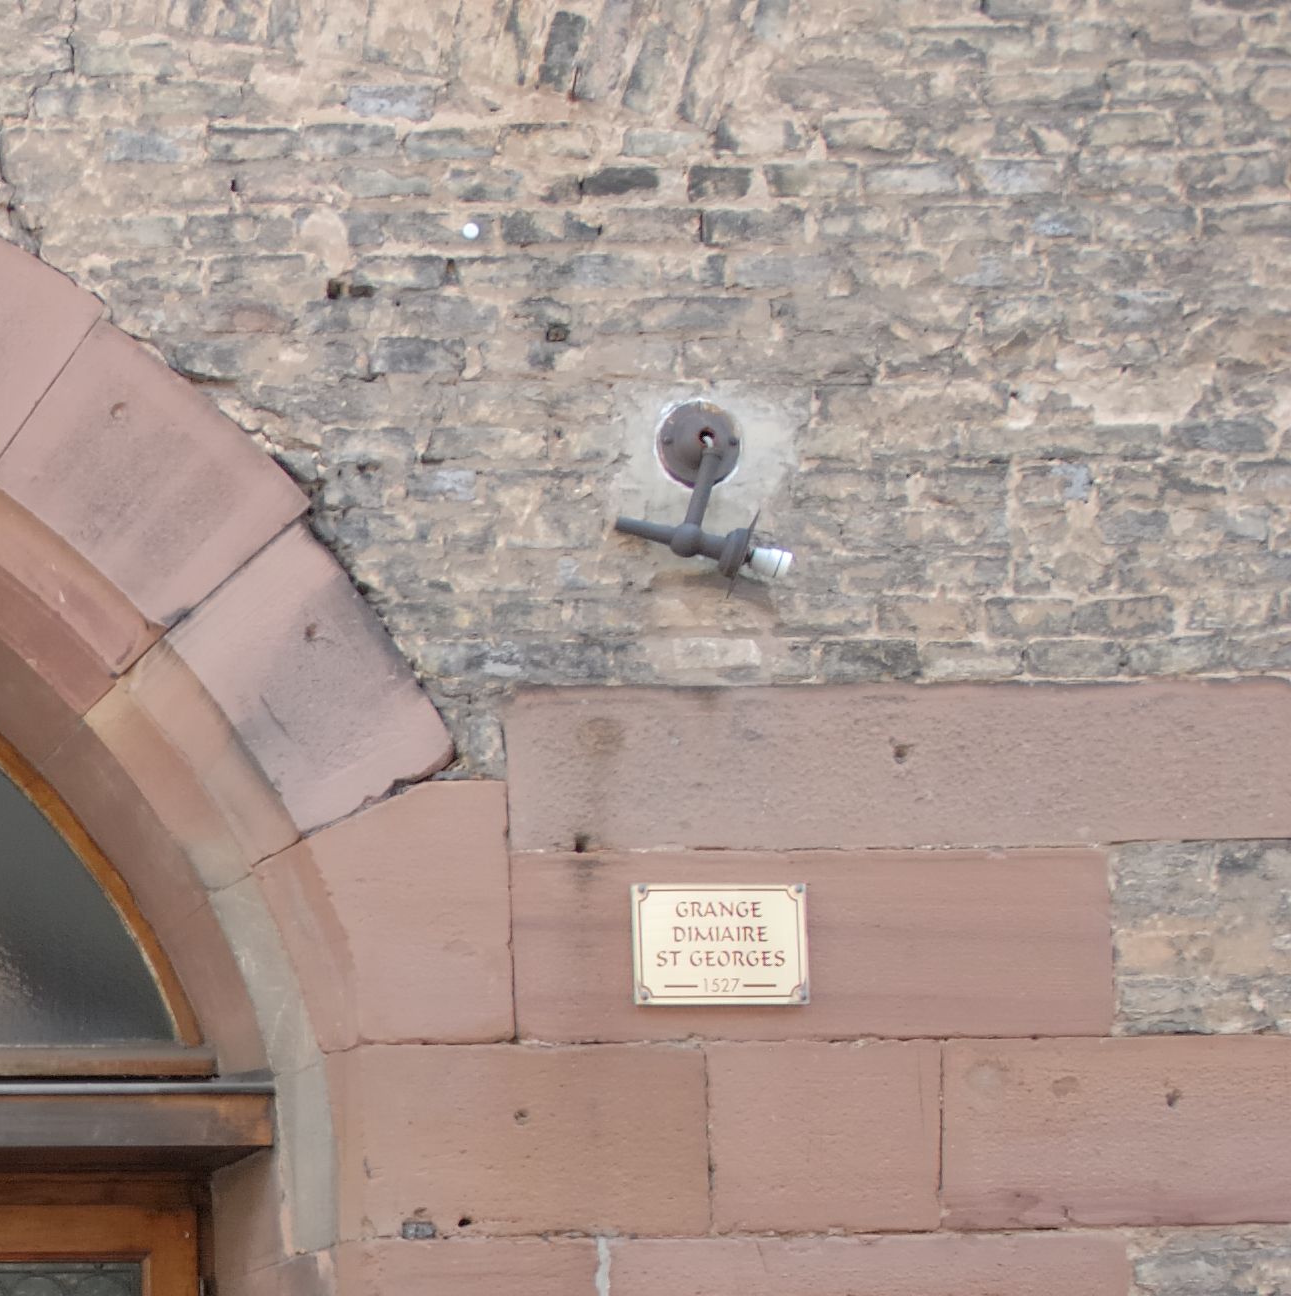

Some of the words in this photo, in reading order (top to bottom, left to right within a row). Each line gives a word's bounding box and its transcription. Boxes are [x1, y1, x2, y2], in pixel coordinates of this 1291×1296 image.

[675, 901, 763, 918] GRANGE
[672, 926, 769, 942] DIMIAIRE
[656, 951, 682, 967] ST
[690, 951, 786, 967] GEORGES
[703, 978, 740, 992] 1527
